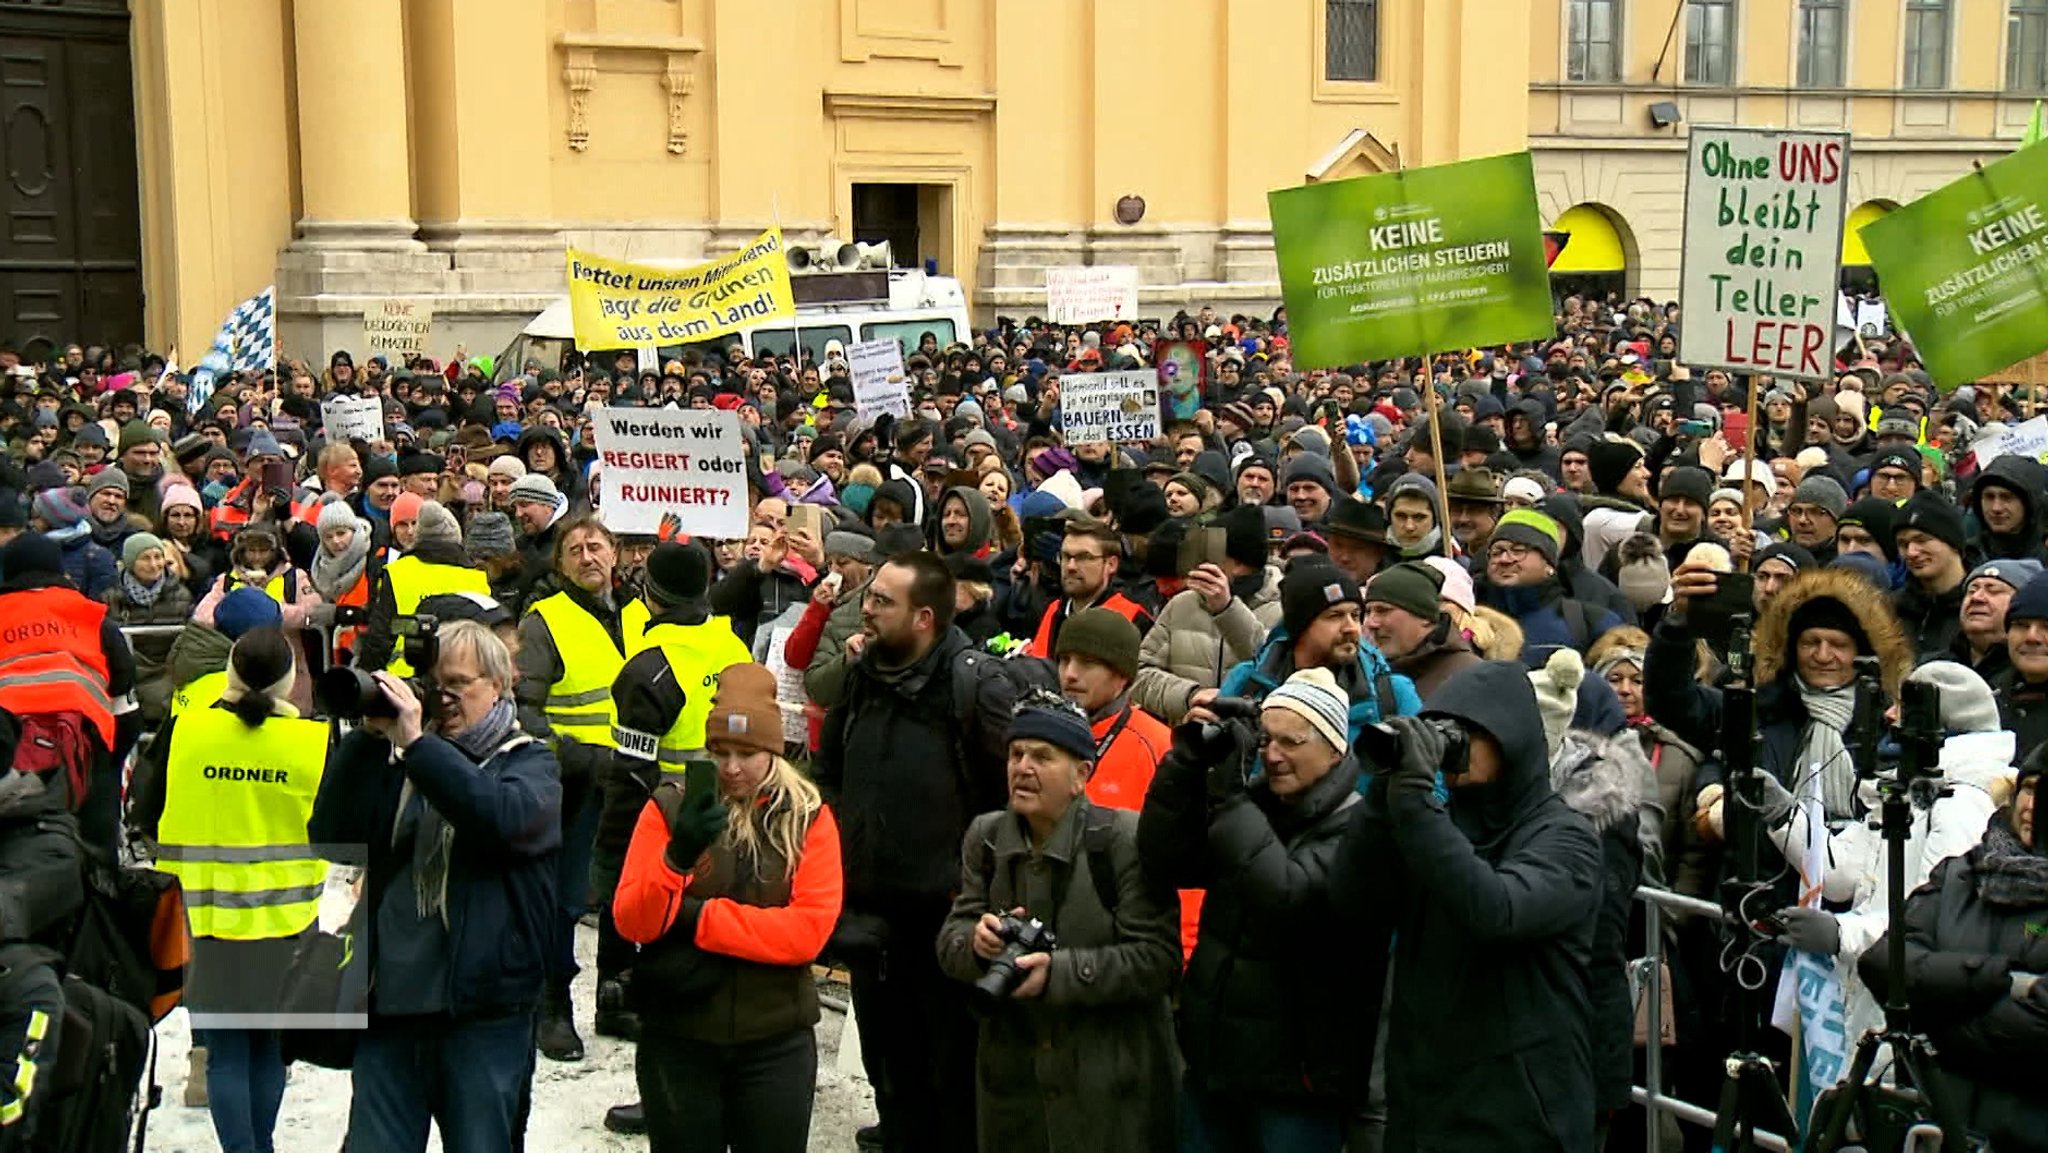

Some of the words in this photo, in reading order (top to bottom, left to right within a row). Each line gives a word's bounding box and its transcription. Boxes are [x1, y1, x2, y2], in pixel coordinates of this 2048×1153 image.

[1702, 140, 1770, 179] Ohne
[1779, 141, 1841, 184] UNS
[1718, 186, 1821, 233] bleibt
[1369, 217, 1445, 250] KEINE
[1967, 204, 2047, 255] KEINE
[1312, 252, 1430, 285] ZUSÄTZLICHEN
[1434, 240, 1510, 267] STEUERN
[1726, 232, 1803, 270] dein
[573, 261, 633, 290] Rettet
[637, 275, 700, 292] unsren
[1924, 241, 2042, 305] ZUSÄTZLICHEN
[597, 291, 640, 321] jagt
[647, 296, 681, 314] die
[1709, 274, 1820, 318] Teller
[616, 325, 654, 341] aus
[657, 319, 710, 340] dem
[711, 291, 777, 327] Land!
[1725, 317, 1825, 374] LEER
[611, 419, 685, 438] Werden
[690, 423, 723, 439] wir
[1063, 409, 1121, 427] BAUERN
[1084, 427, 1101, 441] das
[1106, 423, 1155, 440] ESSEN
[603, 450, 690, 470] REGIERT
[698, 456, 743, 473] oder
[621, 483, 730, 505] RUINIERT?
[203, 765, 288, 783] ORDNER
